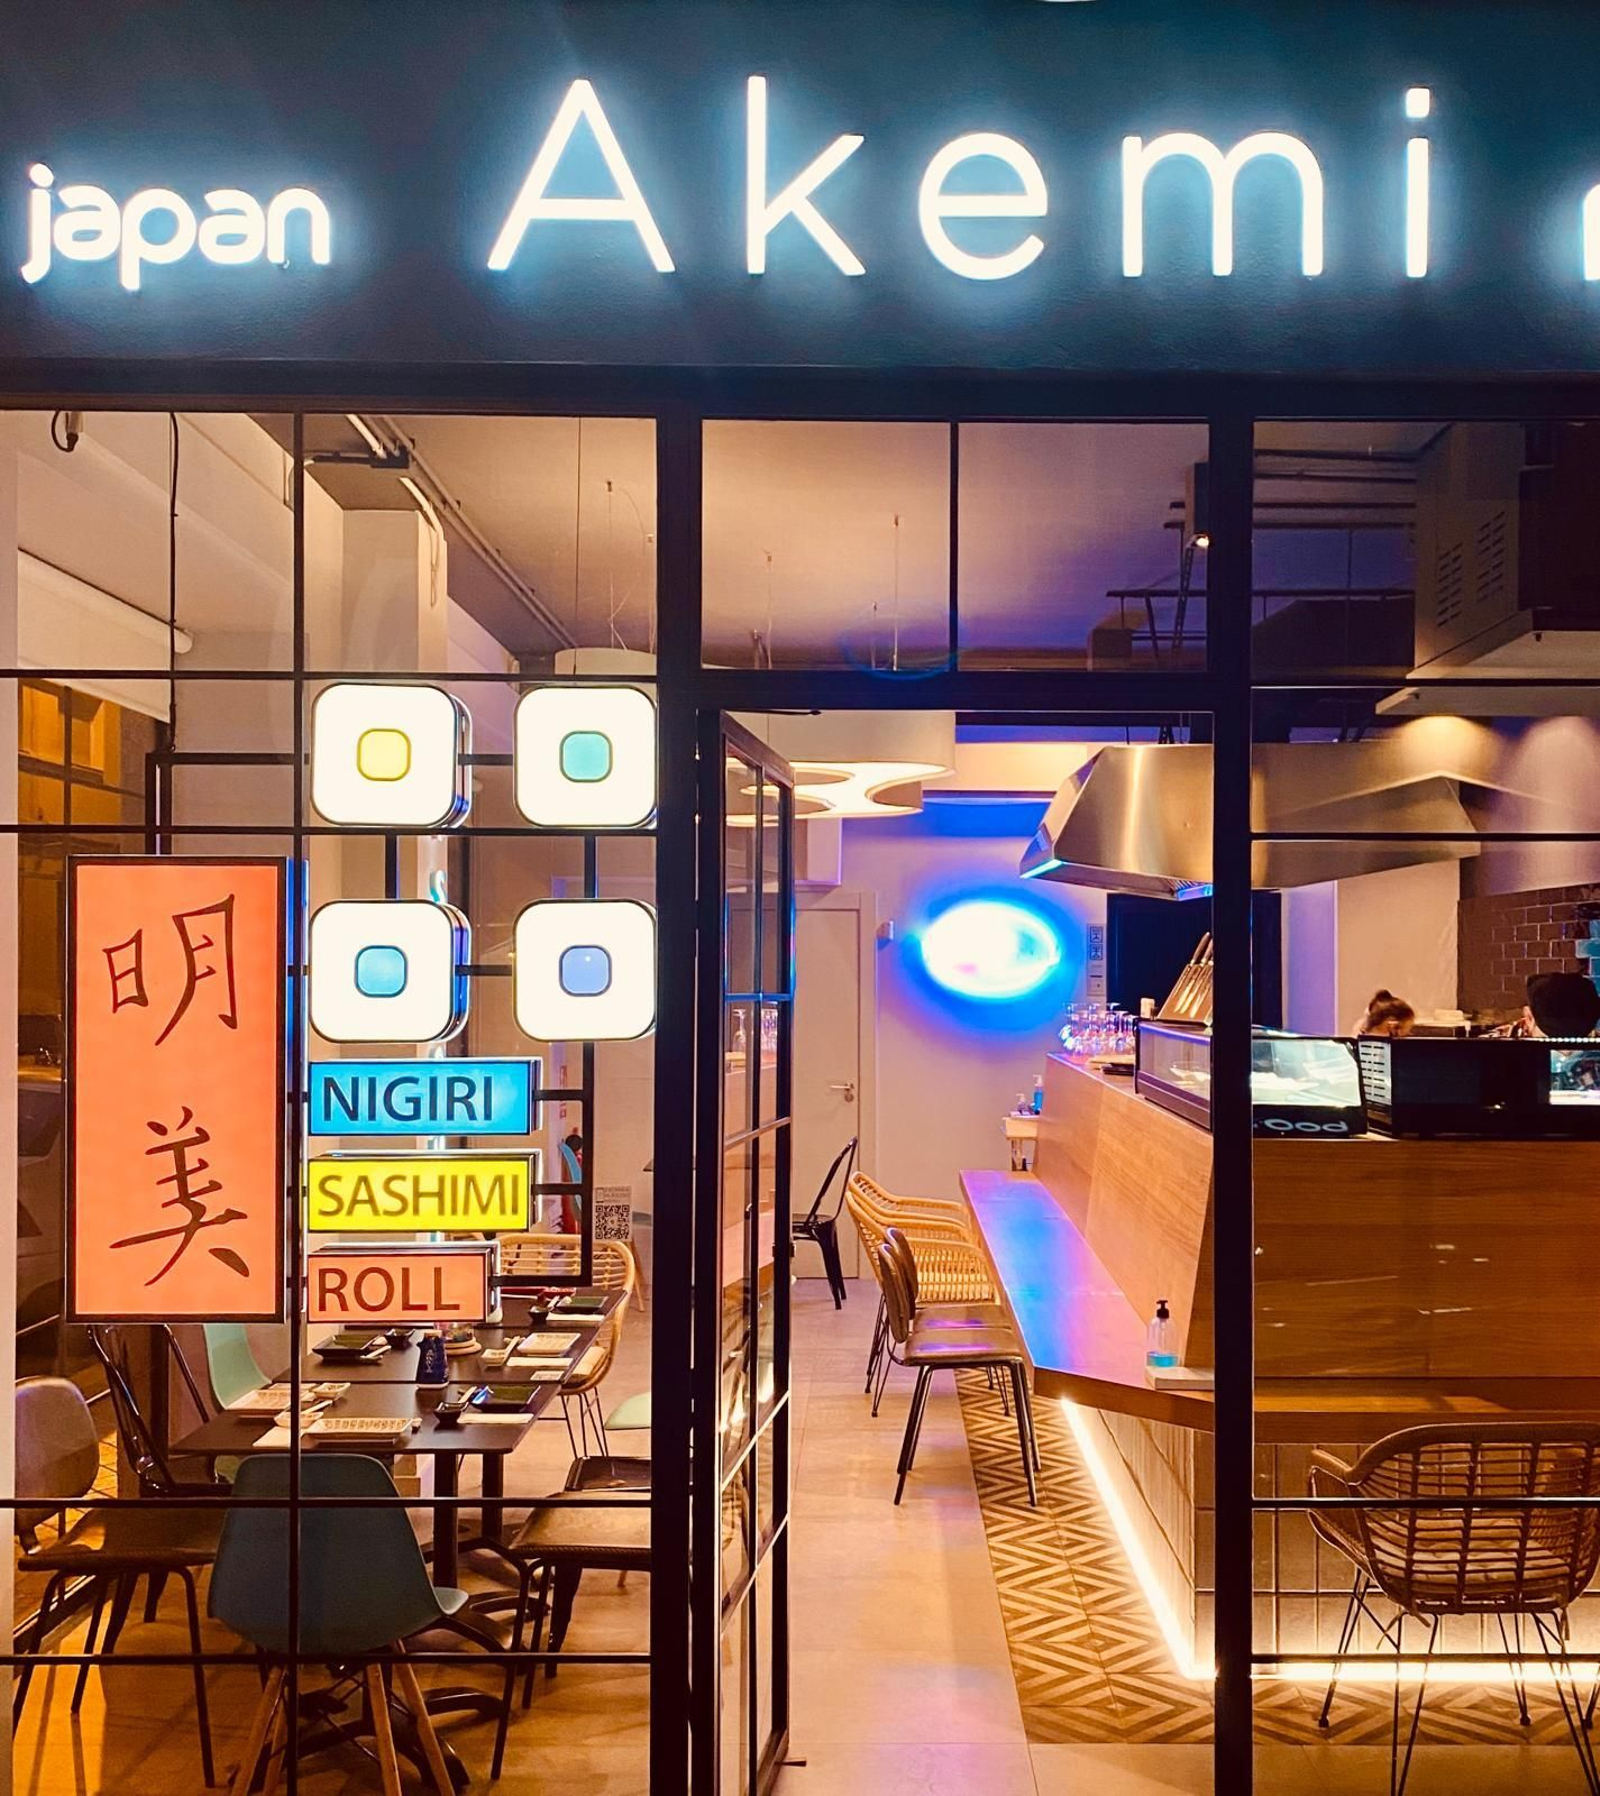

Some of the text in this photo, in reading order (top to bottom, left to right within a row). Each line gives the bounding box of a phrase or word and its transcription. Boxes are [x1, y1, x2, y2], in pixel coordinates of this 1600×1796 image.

[486, 75, 1431, 280] Akemi
[21, 162, 331, 291] japan
[101, 893, 250, 1287] 明美
[322, 1076, 492, 1122] NIGIRI
[316, 1174, 520, 1218] SASHIMI
[317, 1266, 460, 1312] ROLL
